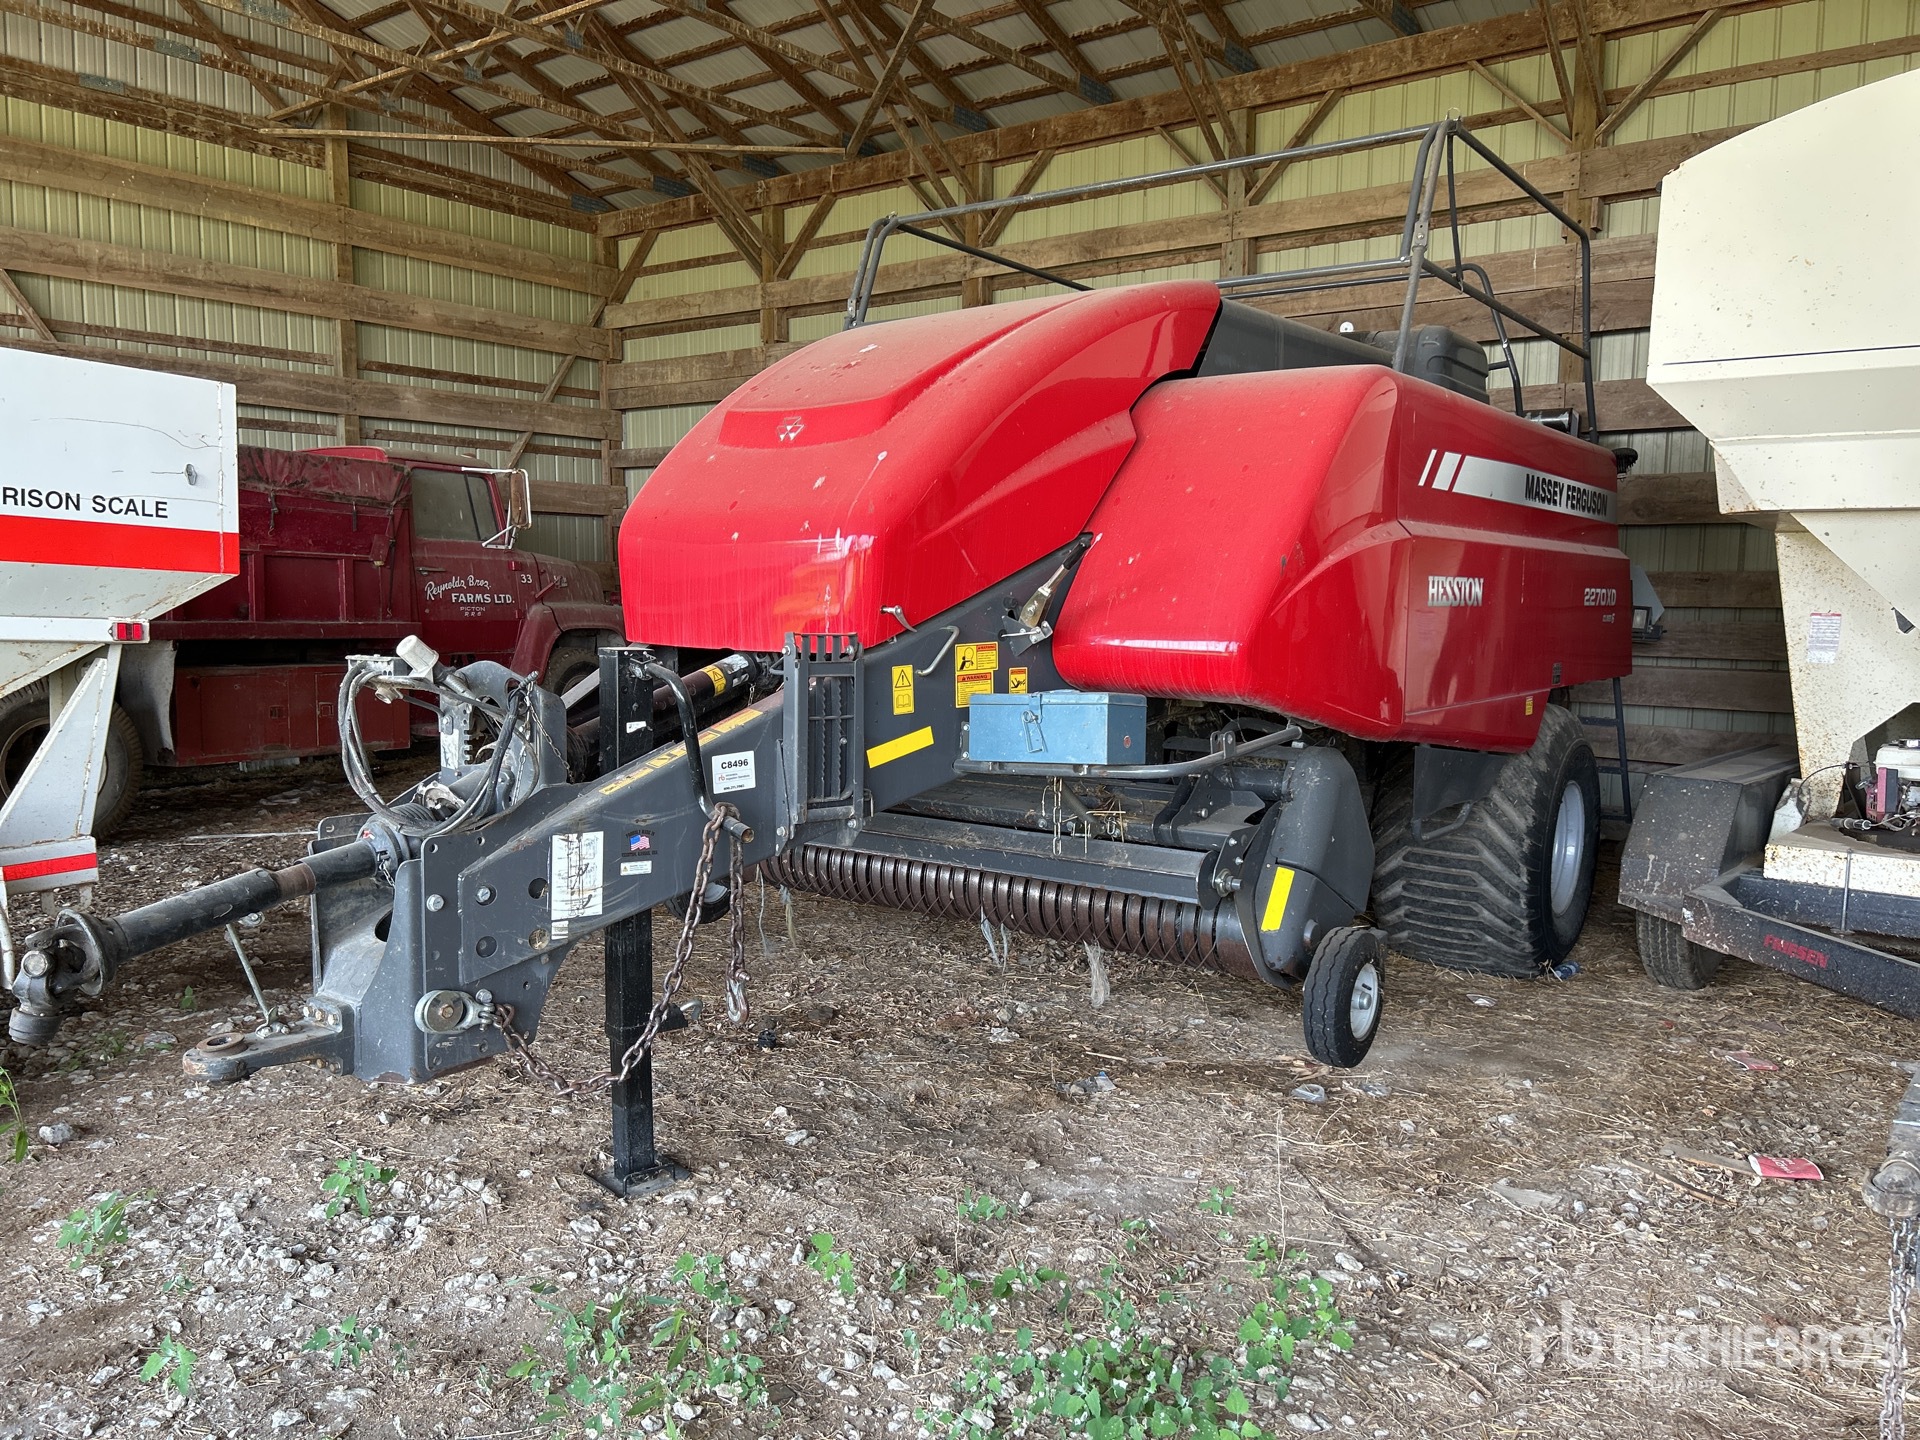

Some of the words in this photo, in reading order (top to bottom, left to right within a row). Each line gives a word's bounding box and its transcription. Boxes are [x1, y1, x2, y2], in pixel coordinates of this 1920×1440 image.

[2, 486, 81, 511] RISON
[91, 495, 169, 519] SCALE
[1525, 473, 1565, 507] MASSEY
[1565, 484, 1608, 516] FERGUSON
[520, 574, 533, 584] 33
[451, 593, 492, 604] FARMS
[494, 594, 515, 604] LTD.
[1427, 575, 1484, 607] HESSTON
[1583, 587, 1617, 607] 2270XD
[720, 758, 749, 770] C8496
